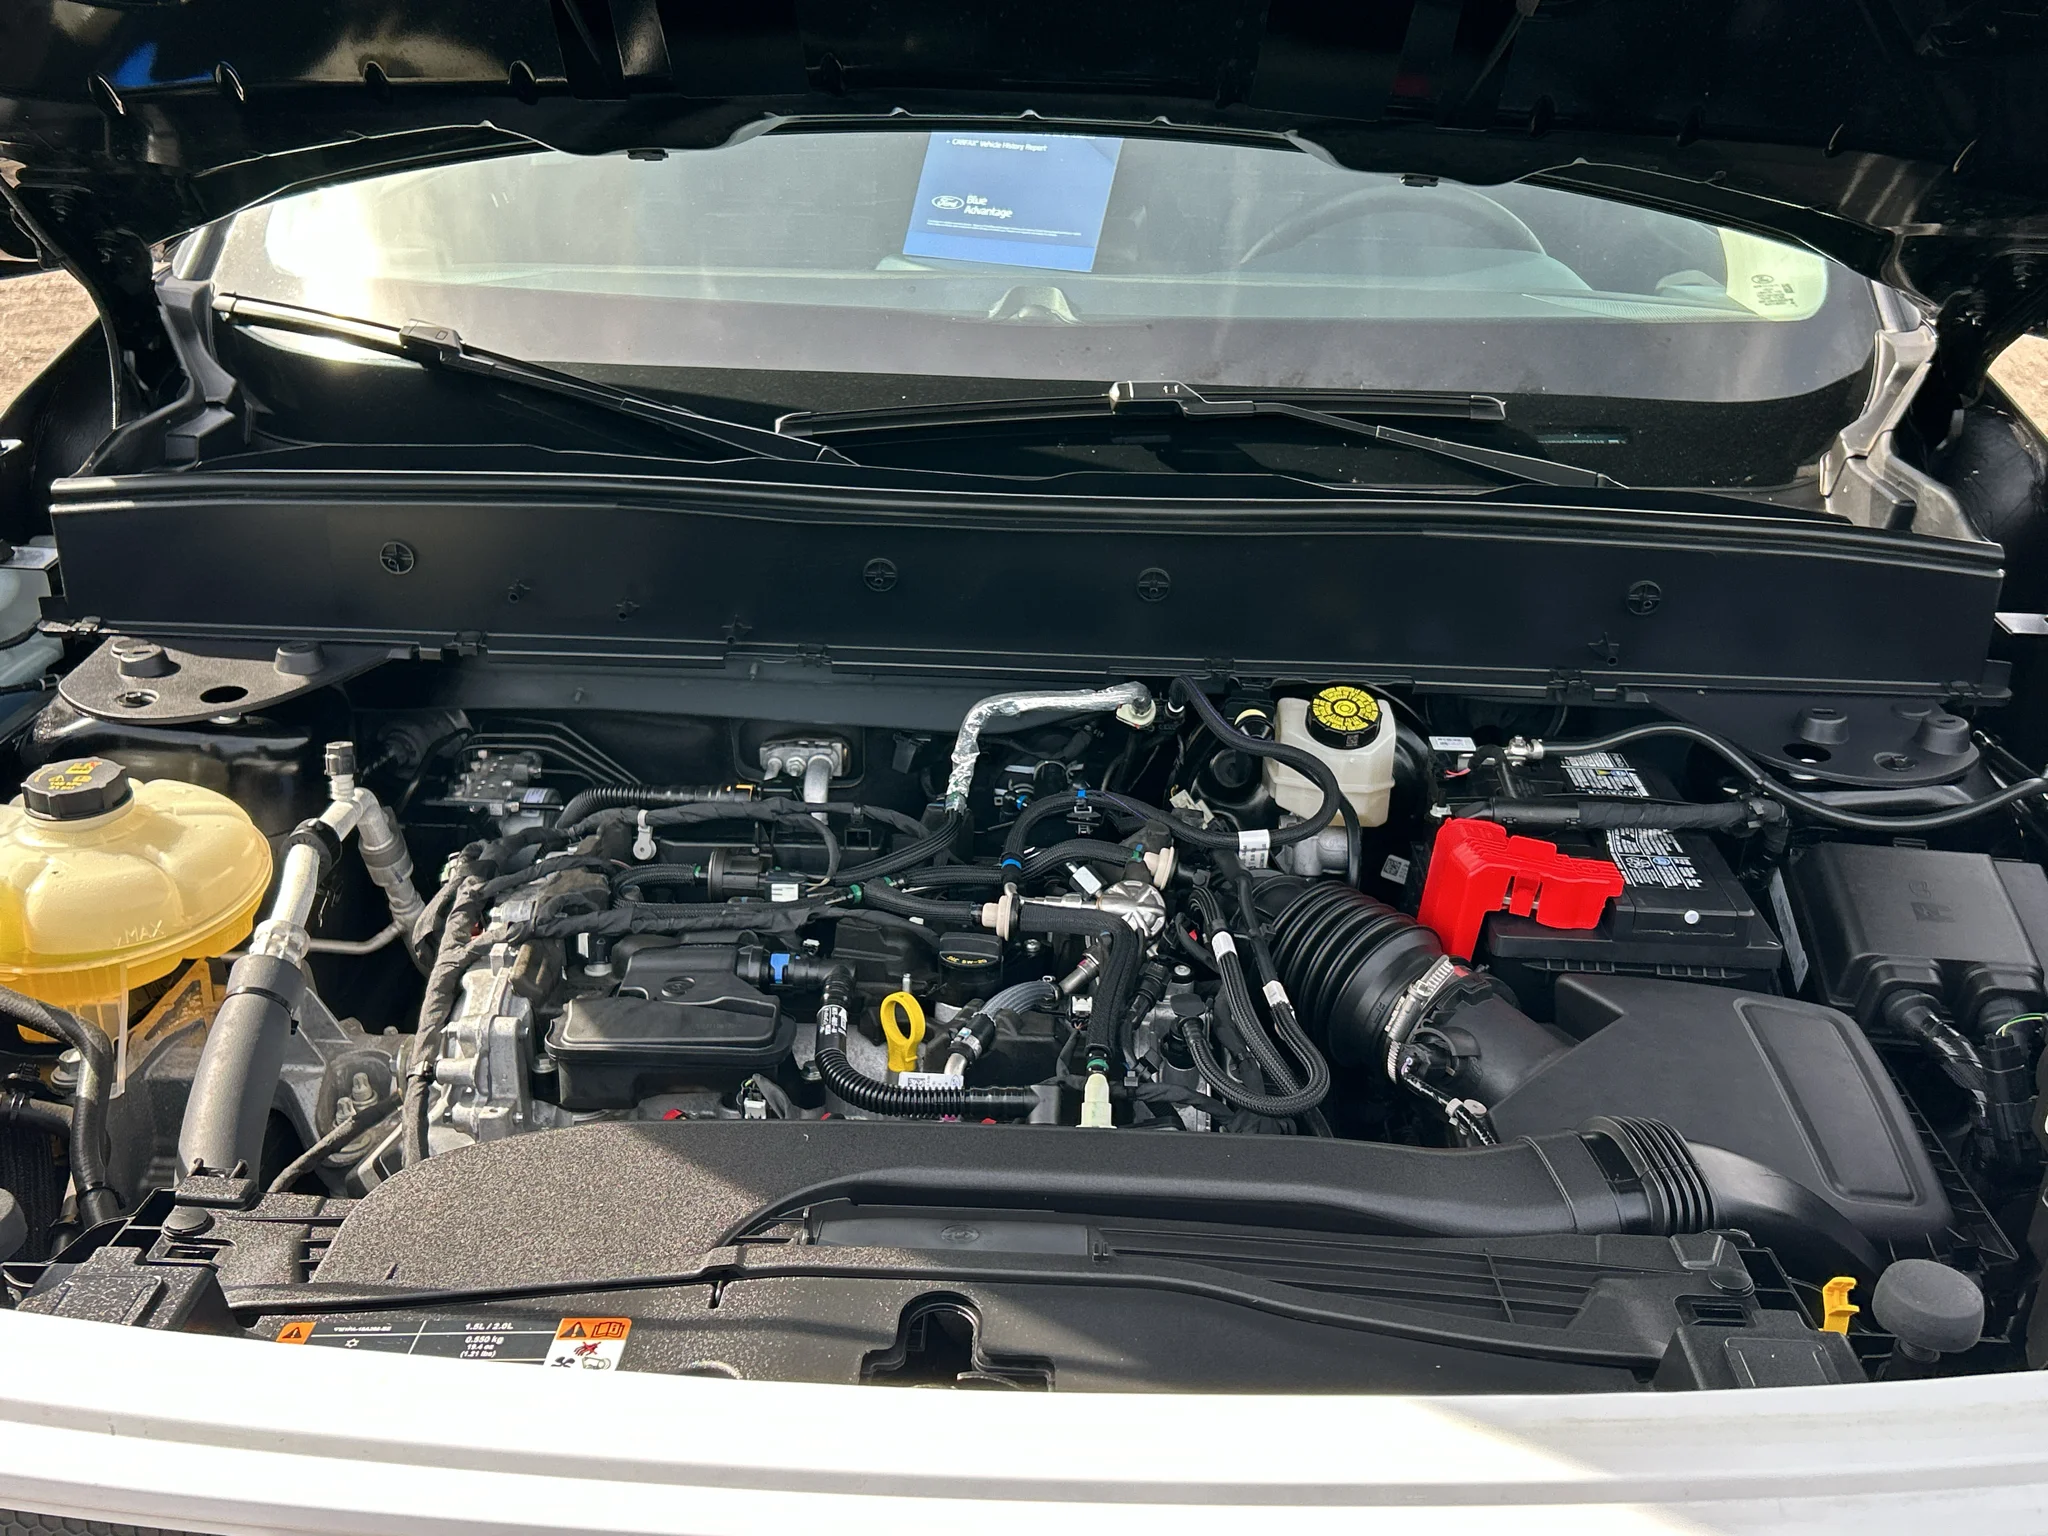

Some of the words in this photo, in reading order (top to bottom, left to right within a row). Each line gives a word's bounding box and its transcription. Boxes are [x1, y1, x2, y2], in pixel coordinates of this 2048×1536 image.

[980, 140, 1002, 149] Vehicle
[1002, 142, 1025, 151] History
[1025, 144, 1048, 152] Report
[966, 195, 988, 206] Blue
[963, 205, 1013, 219] Advantage
[125, 920, 164, 943] MAX
[465, 1322, 485, 1330] 1.5L
[492, 1322, 514, 1330] 2.0L
[491, 1335, 505, 1345] kg
